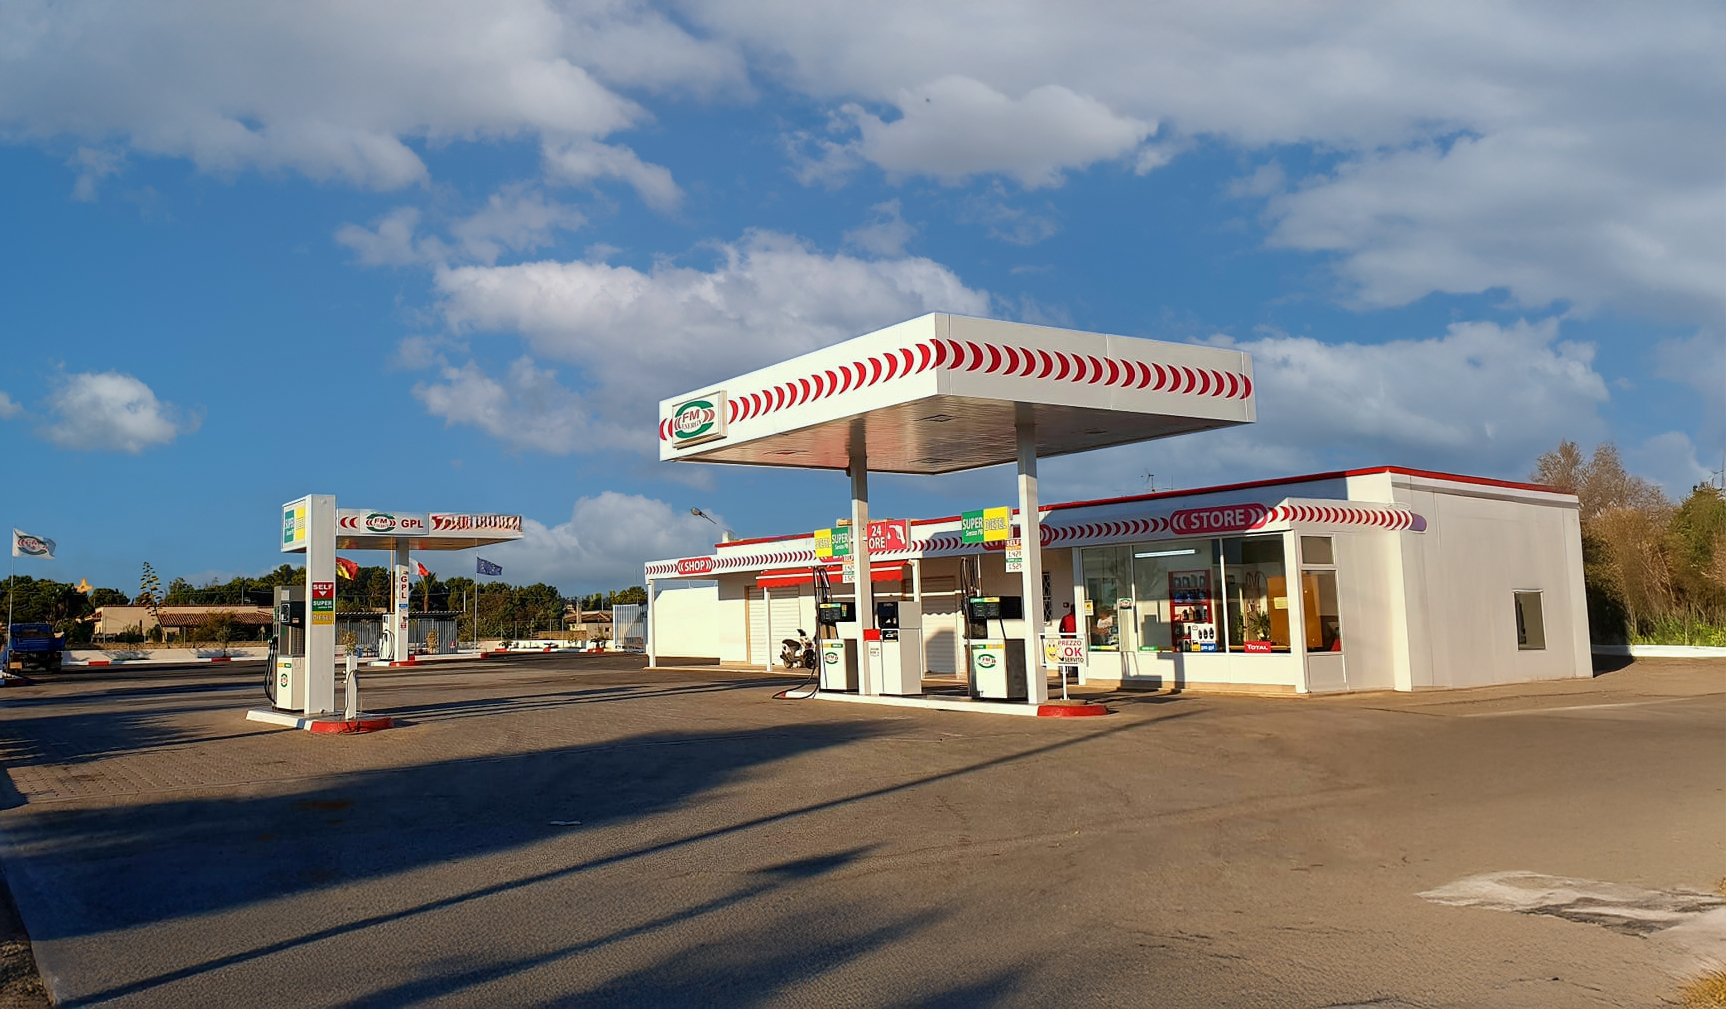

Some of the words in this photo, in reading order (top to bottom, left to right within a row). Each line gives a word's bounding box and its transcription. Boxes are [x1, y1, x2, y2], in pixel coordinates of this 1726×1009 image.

[683, 409, 700, 423] FM
[401, 519, 424, 529] GPL
[962, 516, 983, 530] SUPER
[984, 517, 1006, 532] DIESEL
[1190, 508, 1245, 529] STORE
[871, 525, 882, 537] 24
[831, 533, 849, 545] SUPER
[868, 536, 886, 549] ORE
[684, 560, 706, 572] SHOP
[400, 576, 408, 599] GPL
[1064, 647, 1083, 657] OK
